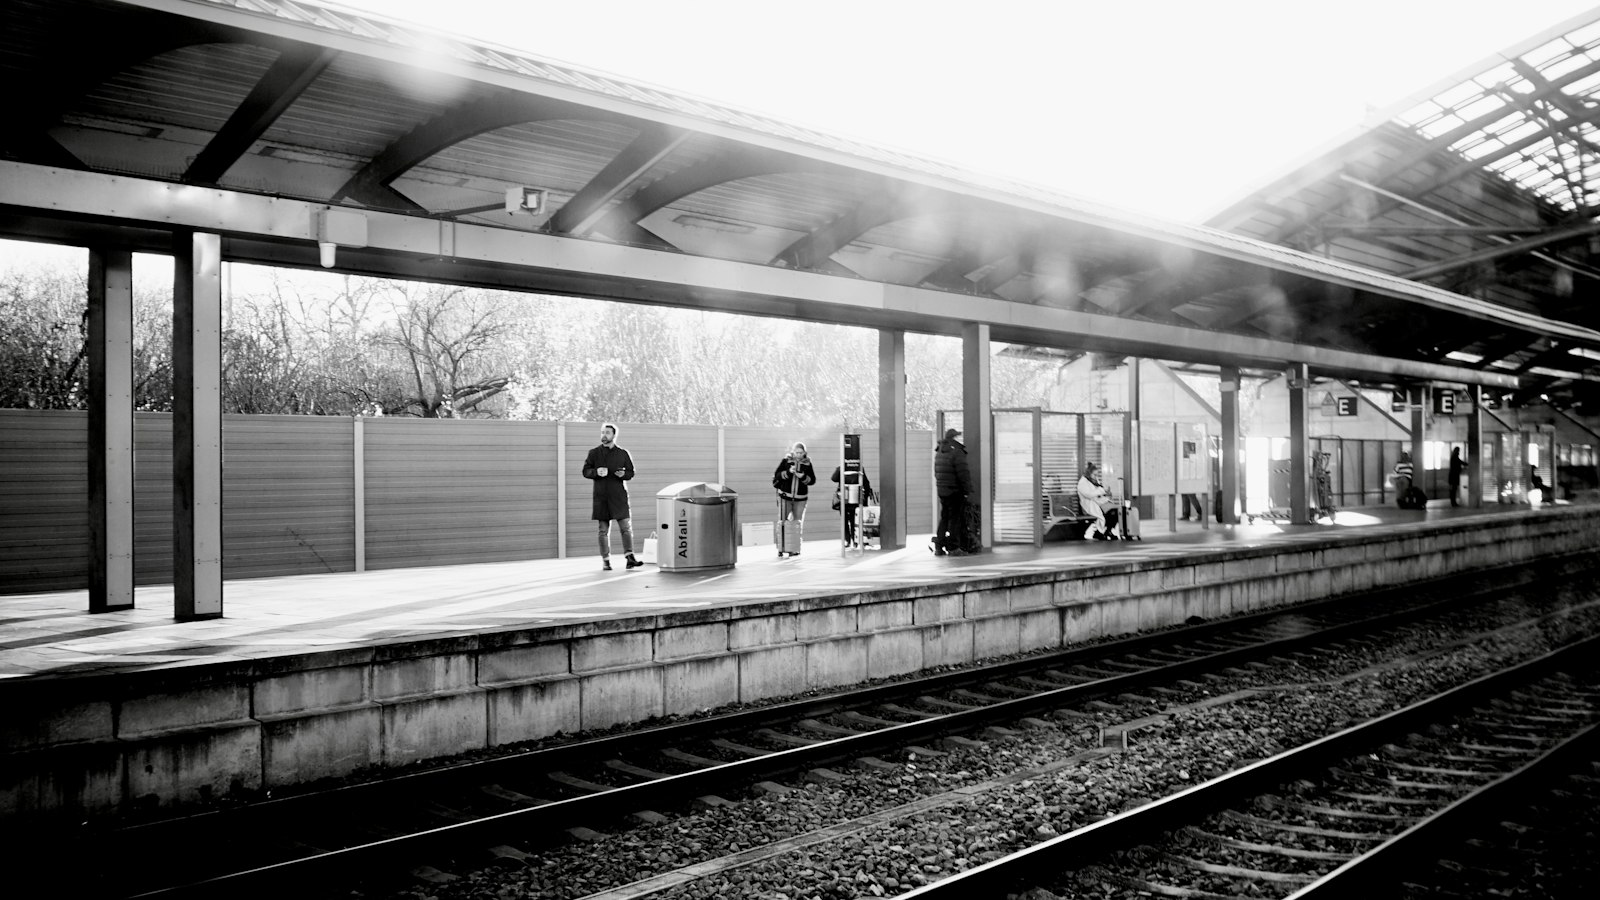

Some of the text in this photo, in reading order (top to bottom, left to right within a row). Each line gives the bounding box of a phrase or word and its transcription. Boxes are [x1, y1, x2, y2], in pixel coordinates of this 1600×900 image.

[1338, 399, 1349, 415] E
[1442, 396, 1453, 413] E
[678, 519, 688, 559] Abfall
